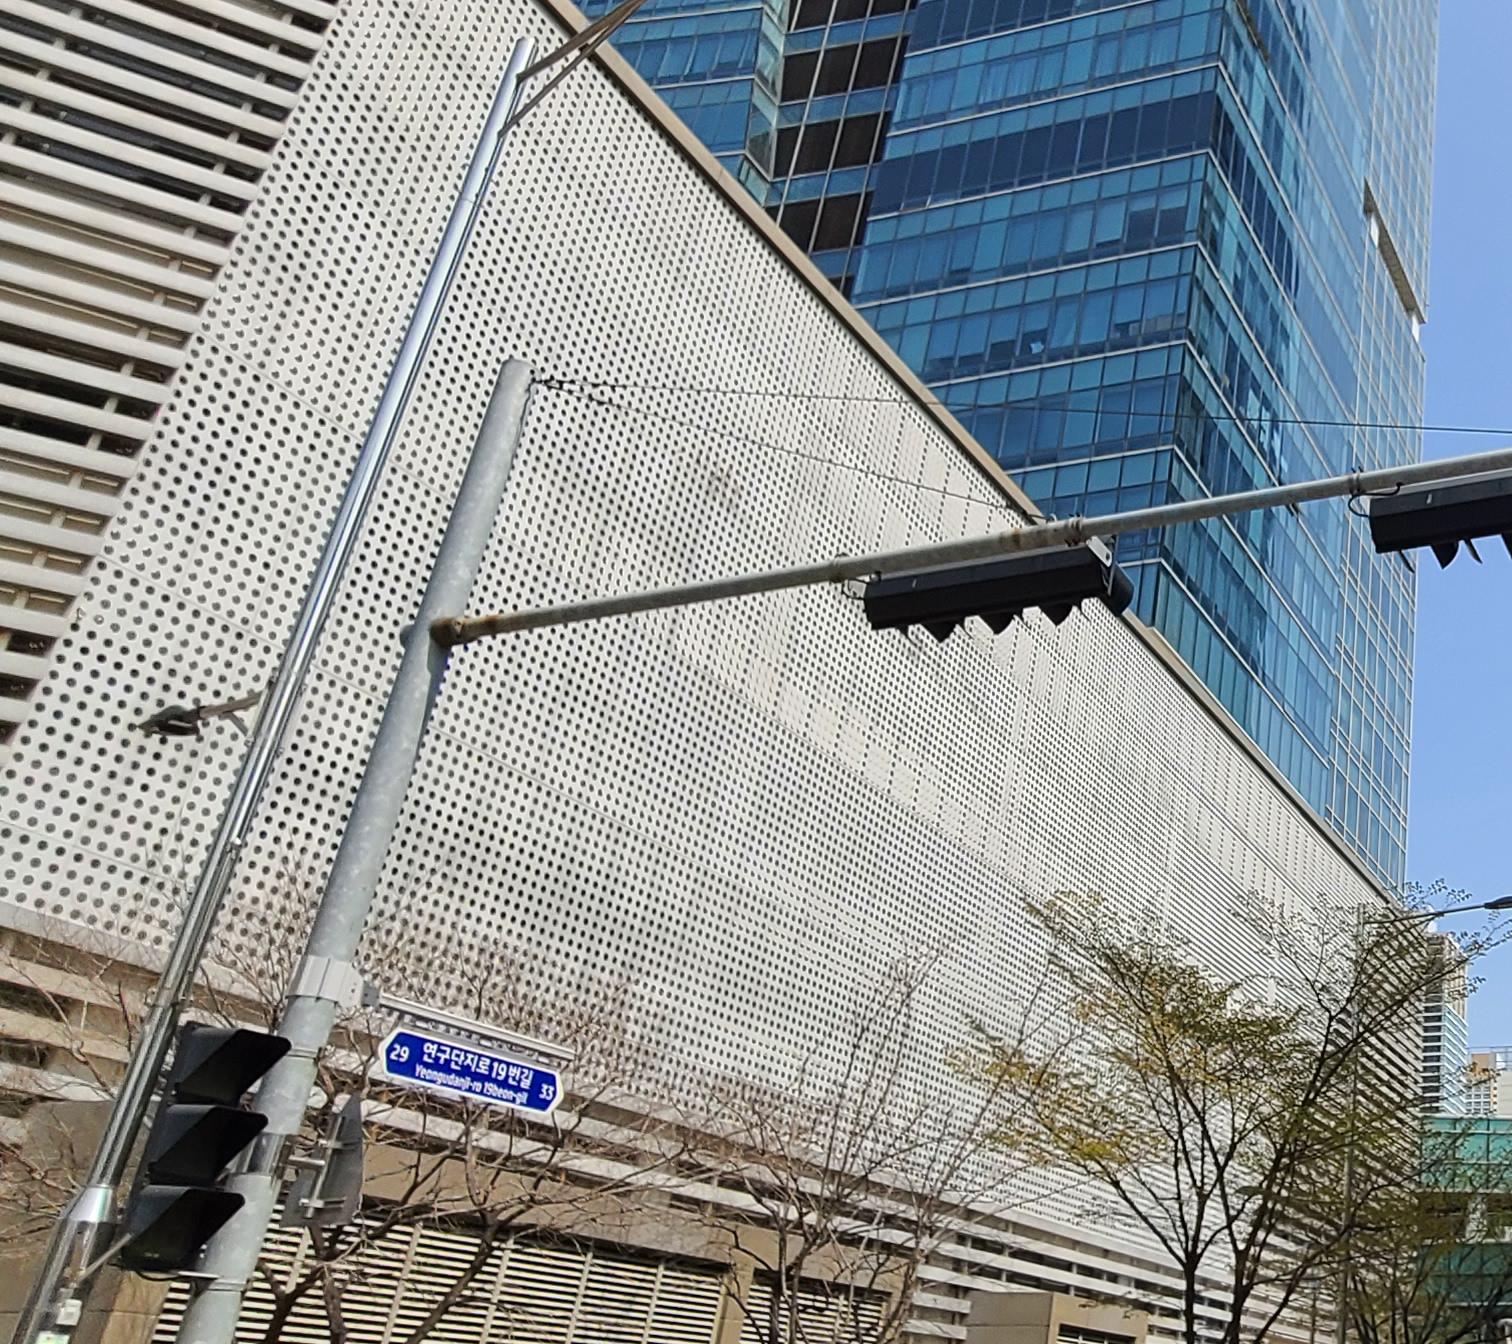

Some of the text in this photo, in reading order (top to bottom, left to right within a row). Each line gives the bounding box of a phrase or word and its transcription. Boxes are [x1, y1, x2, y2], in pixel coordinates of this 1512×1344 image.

[389, 1043, 410, 1063] 29
[422, 1041, 534, 1090] 연구단지로19번길
[415, 1062, 529, 1105] Yeongudanji-ro 19beon-gil
[538, 1083, 555, 1101] 33
